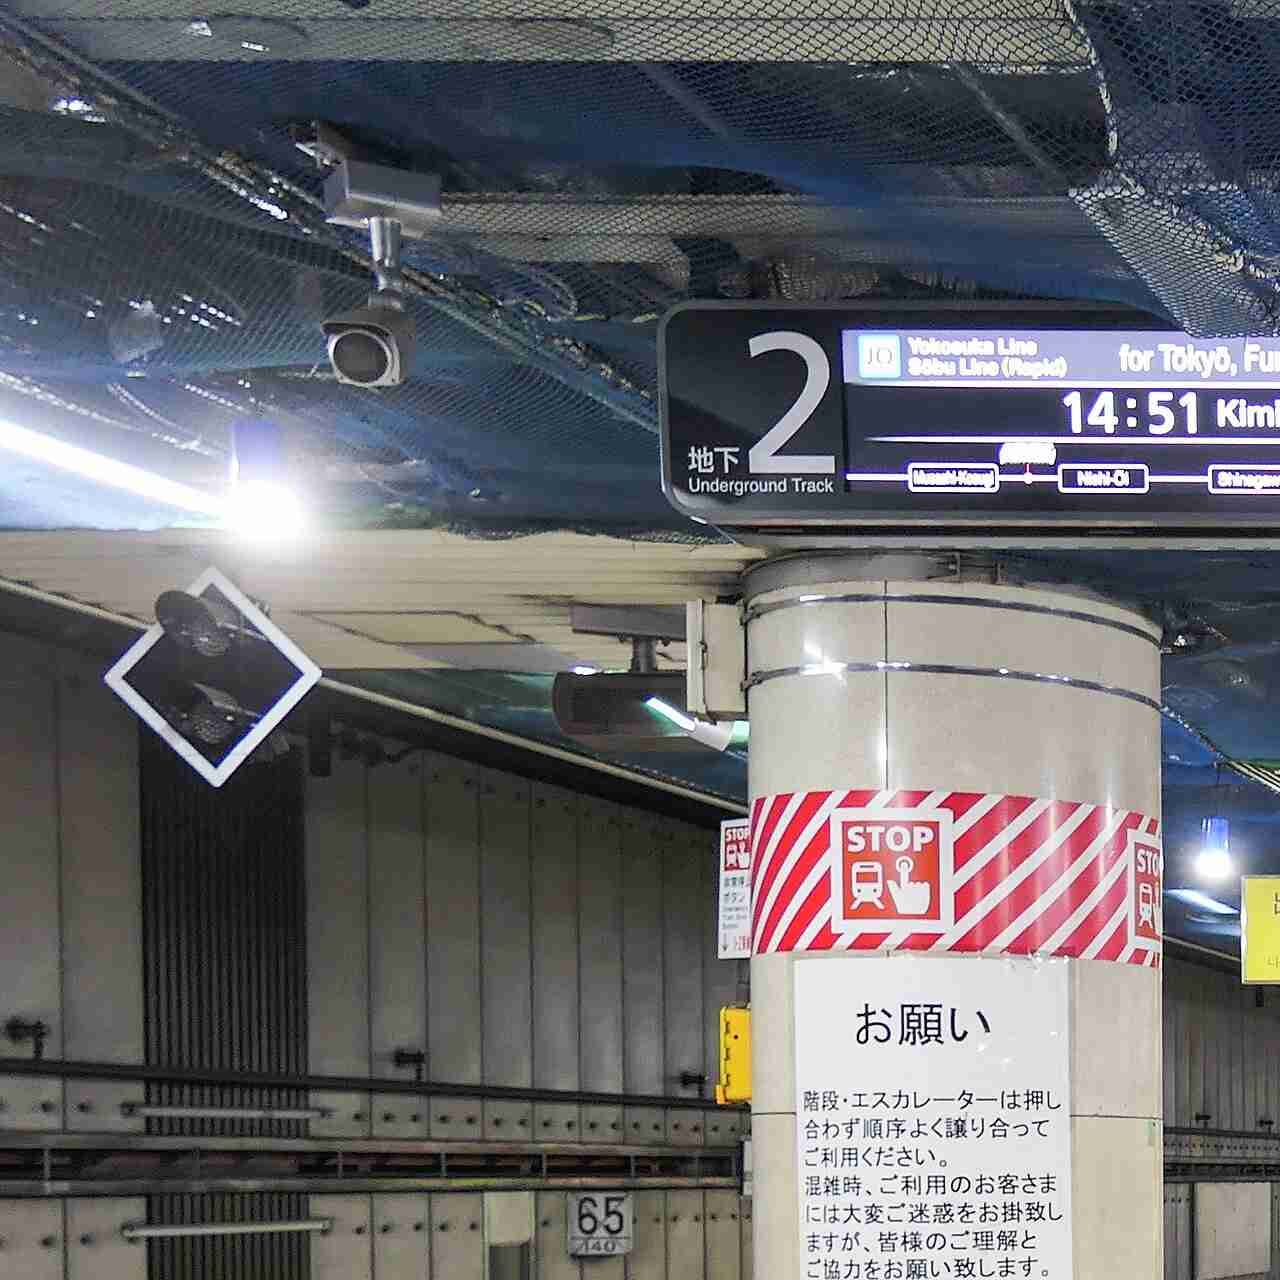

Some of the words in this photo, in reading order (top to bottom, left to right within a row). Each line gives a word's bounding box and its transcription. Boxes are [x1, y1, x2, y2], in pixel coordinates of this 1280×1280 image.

[998, 339, 1038, 356] Line
[1119, 344, 1154, 372] for
[960, 359, 999, 377] Line
[748, 331, 835, 473] 2
[1063, 391, 1198, 435] 14:51
[688, 446, 740, 474] 地下
[688, 478, 787, 497] Underground
[793, 478, 834, 494] Track
[847, 825, 934, 853] STOP
[1136, 850, 1162, 875] STO
[856, 1003, 991, 1046] お願い
[803, 1089, 1062, 1111] 階段・エスカレーターは押し
[804, 1118, 1050, 1139] 合わず順序よく譲り合って
[804, 1147, 948, 1168] ご利用ください。
[804, 1174, 1057, 1198] 混雑時、ご利用のお客さま
[579, 1197, 624, 1234] 65
[805, 1201, 1063, 1224] には大変ご迷惑をお掛致し
[806, 1230, 1037, 1252] ますが、皆様のご理解と
[807, 1256, 1050, 1280] ご協力をお願い致します。
